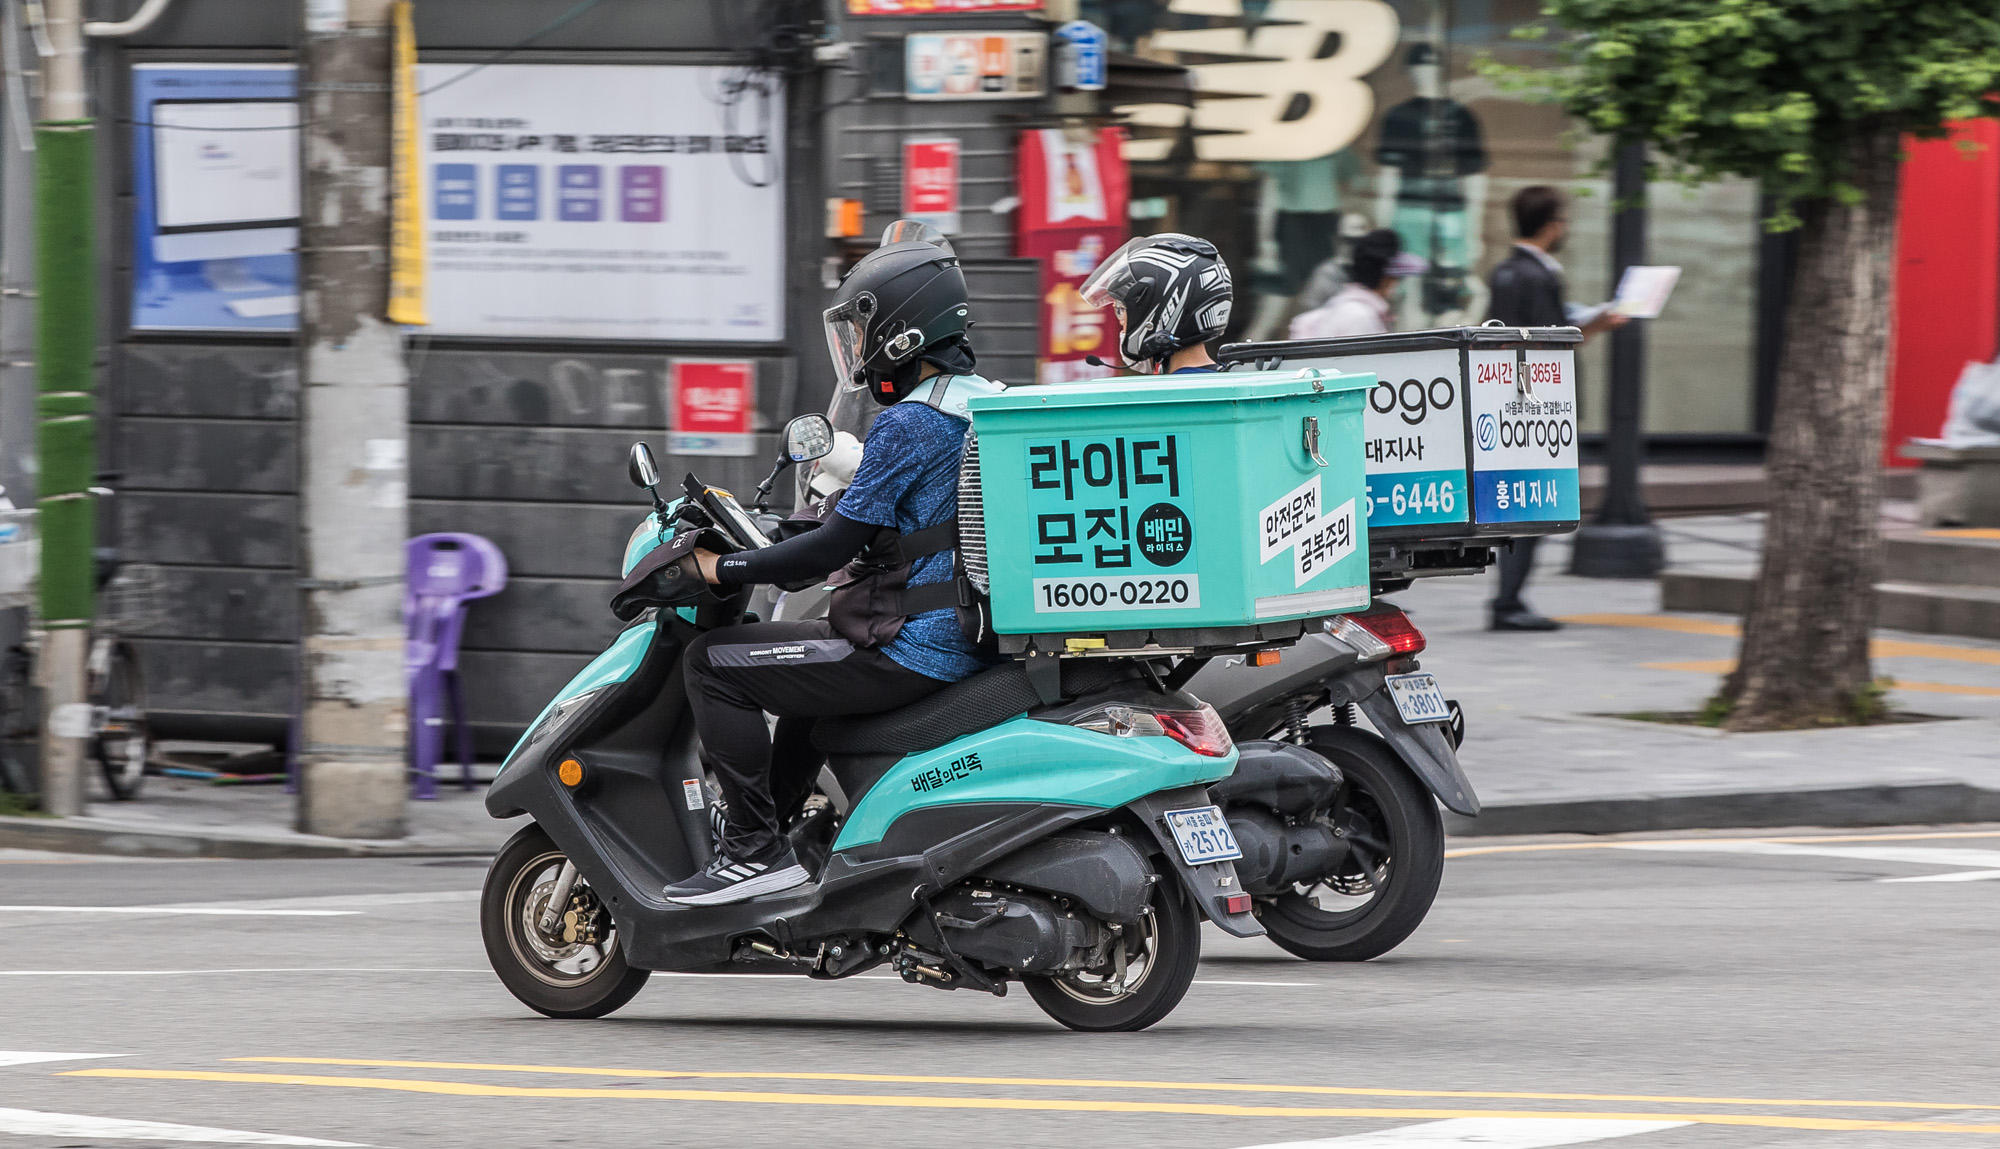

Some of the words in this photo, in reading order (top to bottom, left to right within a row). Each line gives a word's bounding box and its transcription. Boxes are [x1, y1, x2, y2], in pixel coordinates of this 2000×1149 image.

[1477, 362, 1513, 385] 24시간
[1531, 361, 1562, 384] 365일
[1504, 401, 1524, 415] 마음과
[1543, 401, 1573, 415] 연결합니다
[1499, 409, 1573, 458] barogo
[1029, 434, 1180, 501] 라이더
[1496, 479, 1558, 510] 홍대지사
[1144, 517, 1184, 542] 배민
[1266, 487, 1316, 548] 안전운전
[1035, 505, 1132, 569] 모집
[1146, 543, 1185, 554] 라이더스
[1300, 513, 1350, 575] 공복주의
[1042, 579, 1189, 608] 1600-0220
[772, 645, 806, 655] MOVEMENT
[1408, 693, 1444, 715] 3801
[910, 752, 983, 793] 배달의민족
[1184, 815, 1198, 828] 서울
[1191, 828, 1235, 854] 2512
